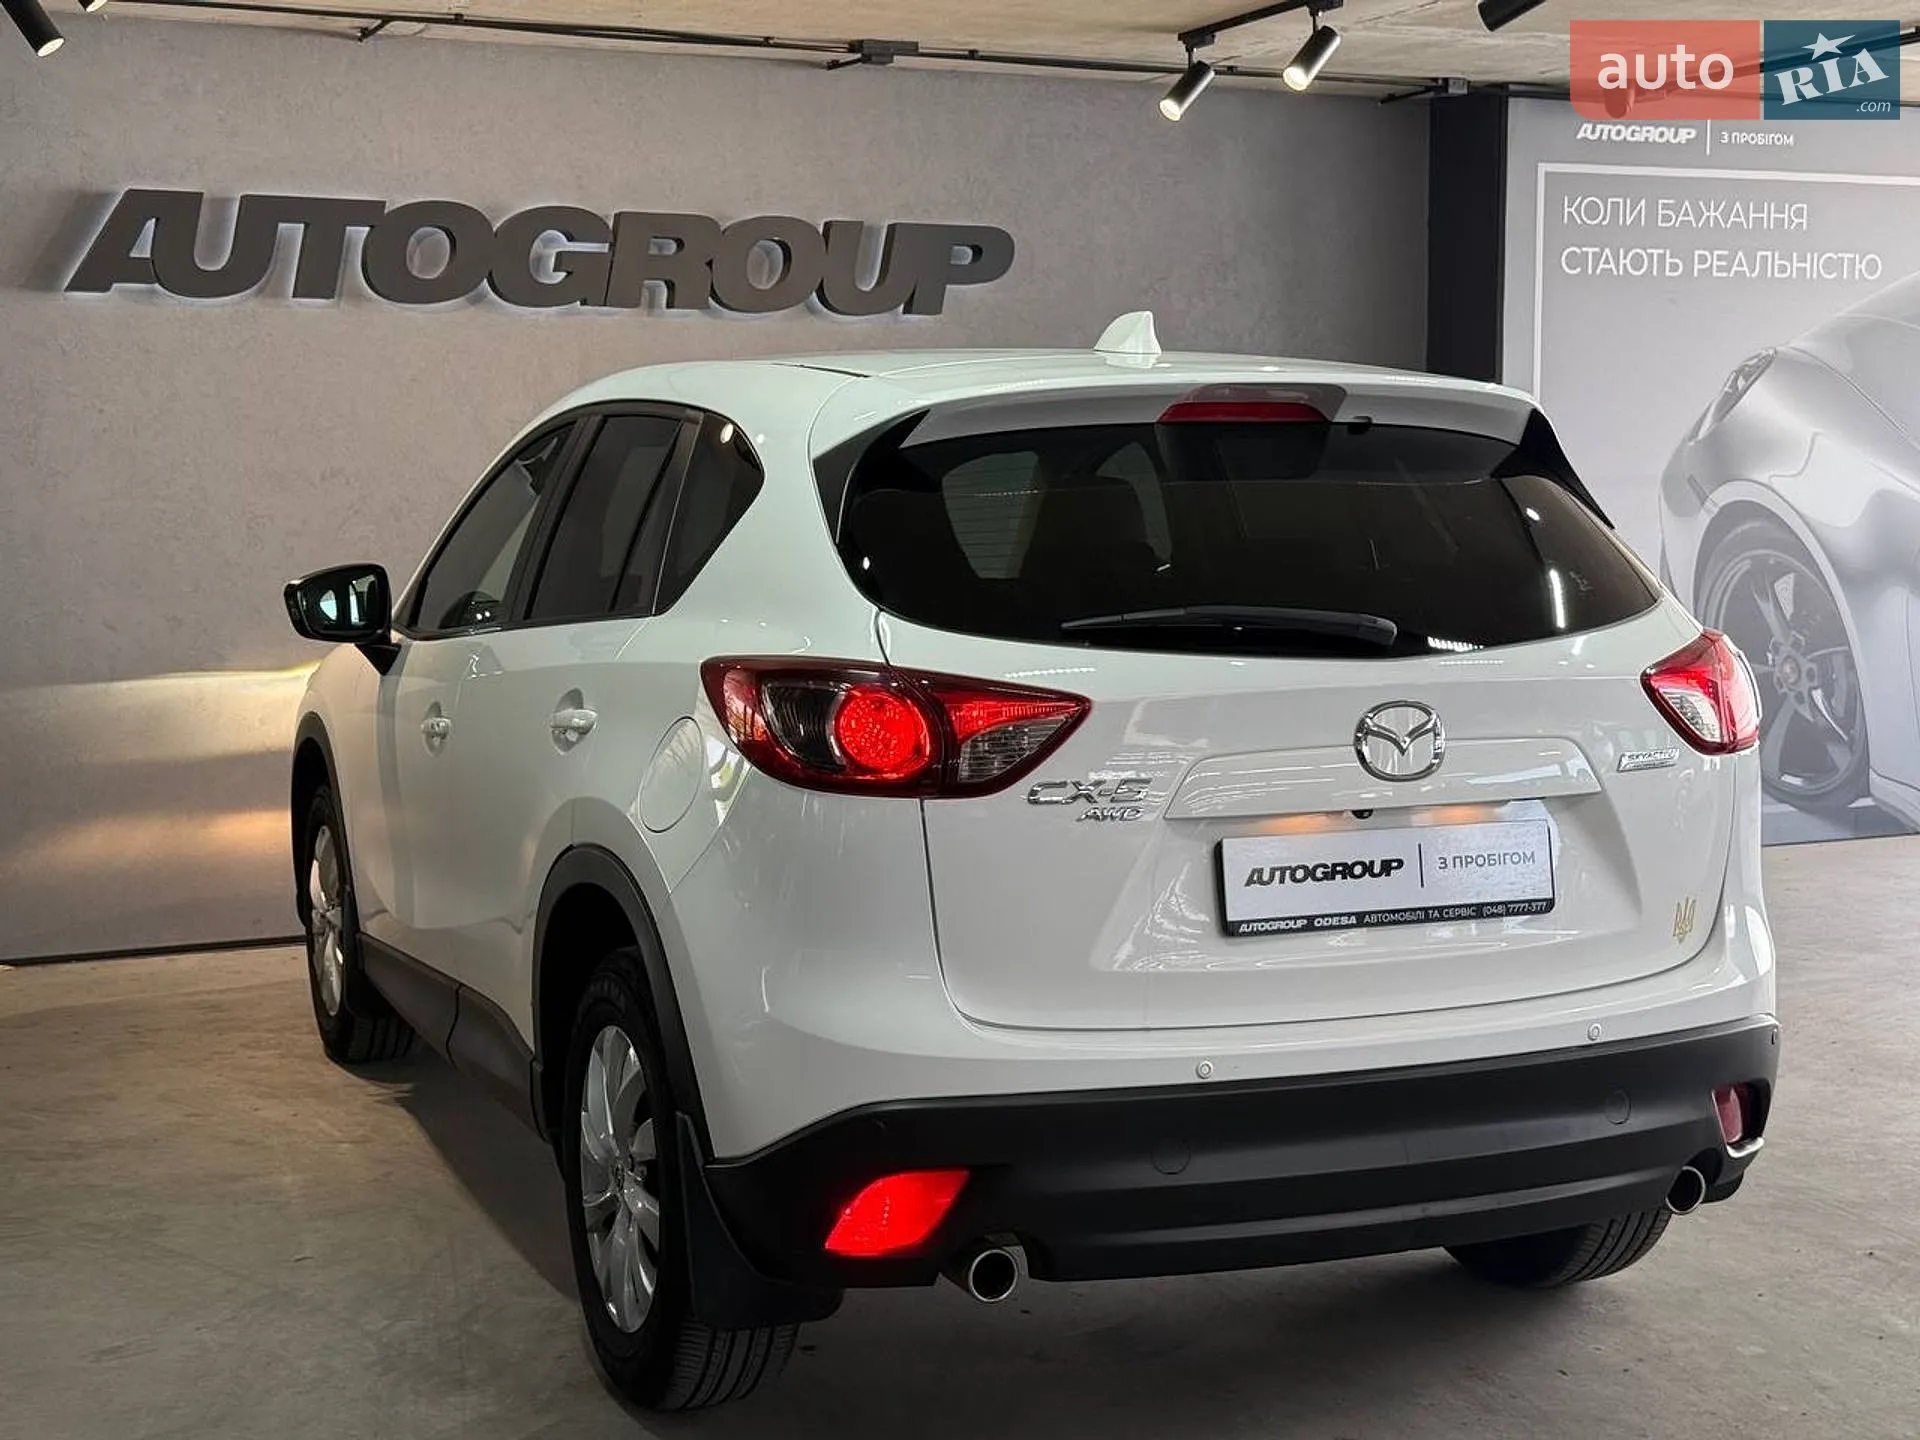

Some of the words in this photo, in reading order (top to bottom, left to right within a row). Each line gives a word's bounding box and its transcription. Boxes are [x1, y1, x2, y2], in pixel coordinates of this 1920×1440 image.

[1576, 123, 1697, 144] AUTOGROUP
[1732, 132, 1794, 146] ПРОБІГОМ
[1562, 196, 1646, 228] КОЛИ
[1657, 199, 1808, 231] БАЖАННЯ
[64, 188, 1015, 317] AUTOGROUP
[1561, 246, 1684, 277] СТАЮТЬ
[1693, 250, 1883, 281] РЕАЛЬНІСТЮ
[1027, 777, 1152, 804] CX-5
[1076, 805, 1144, 822] AWD
[1244, 858, 1404, 887] AUTOGROUP
[1452, 851, 1536, 868] ПРОБІГОМ
[1238, 919, 1308, 934] AUTOGROUP
[1314, 916, 1357, 927] ODESA
[1363, 912, 1425, 924] АВТОМОБІЛІ
[1428, 910, 1440, 920] ТА
[1443, 907, 1477, 918] СЕРВІС
